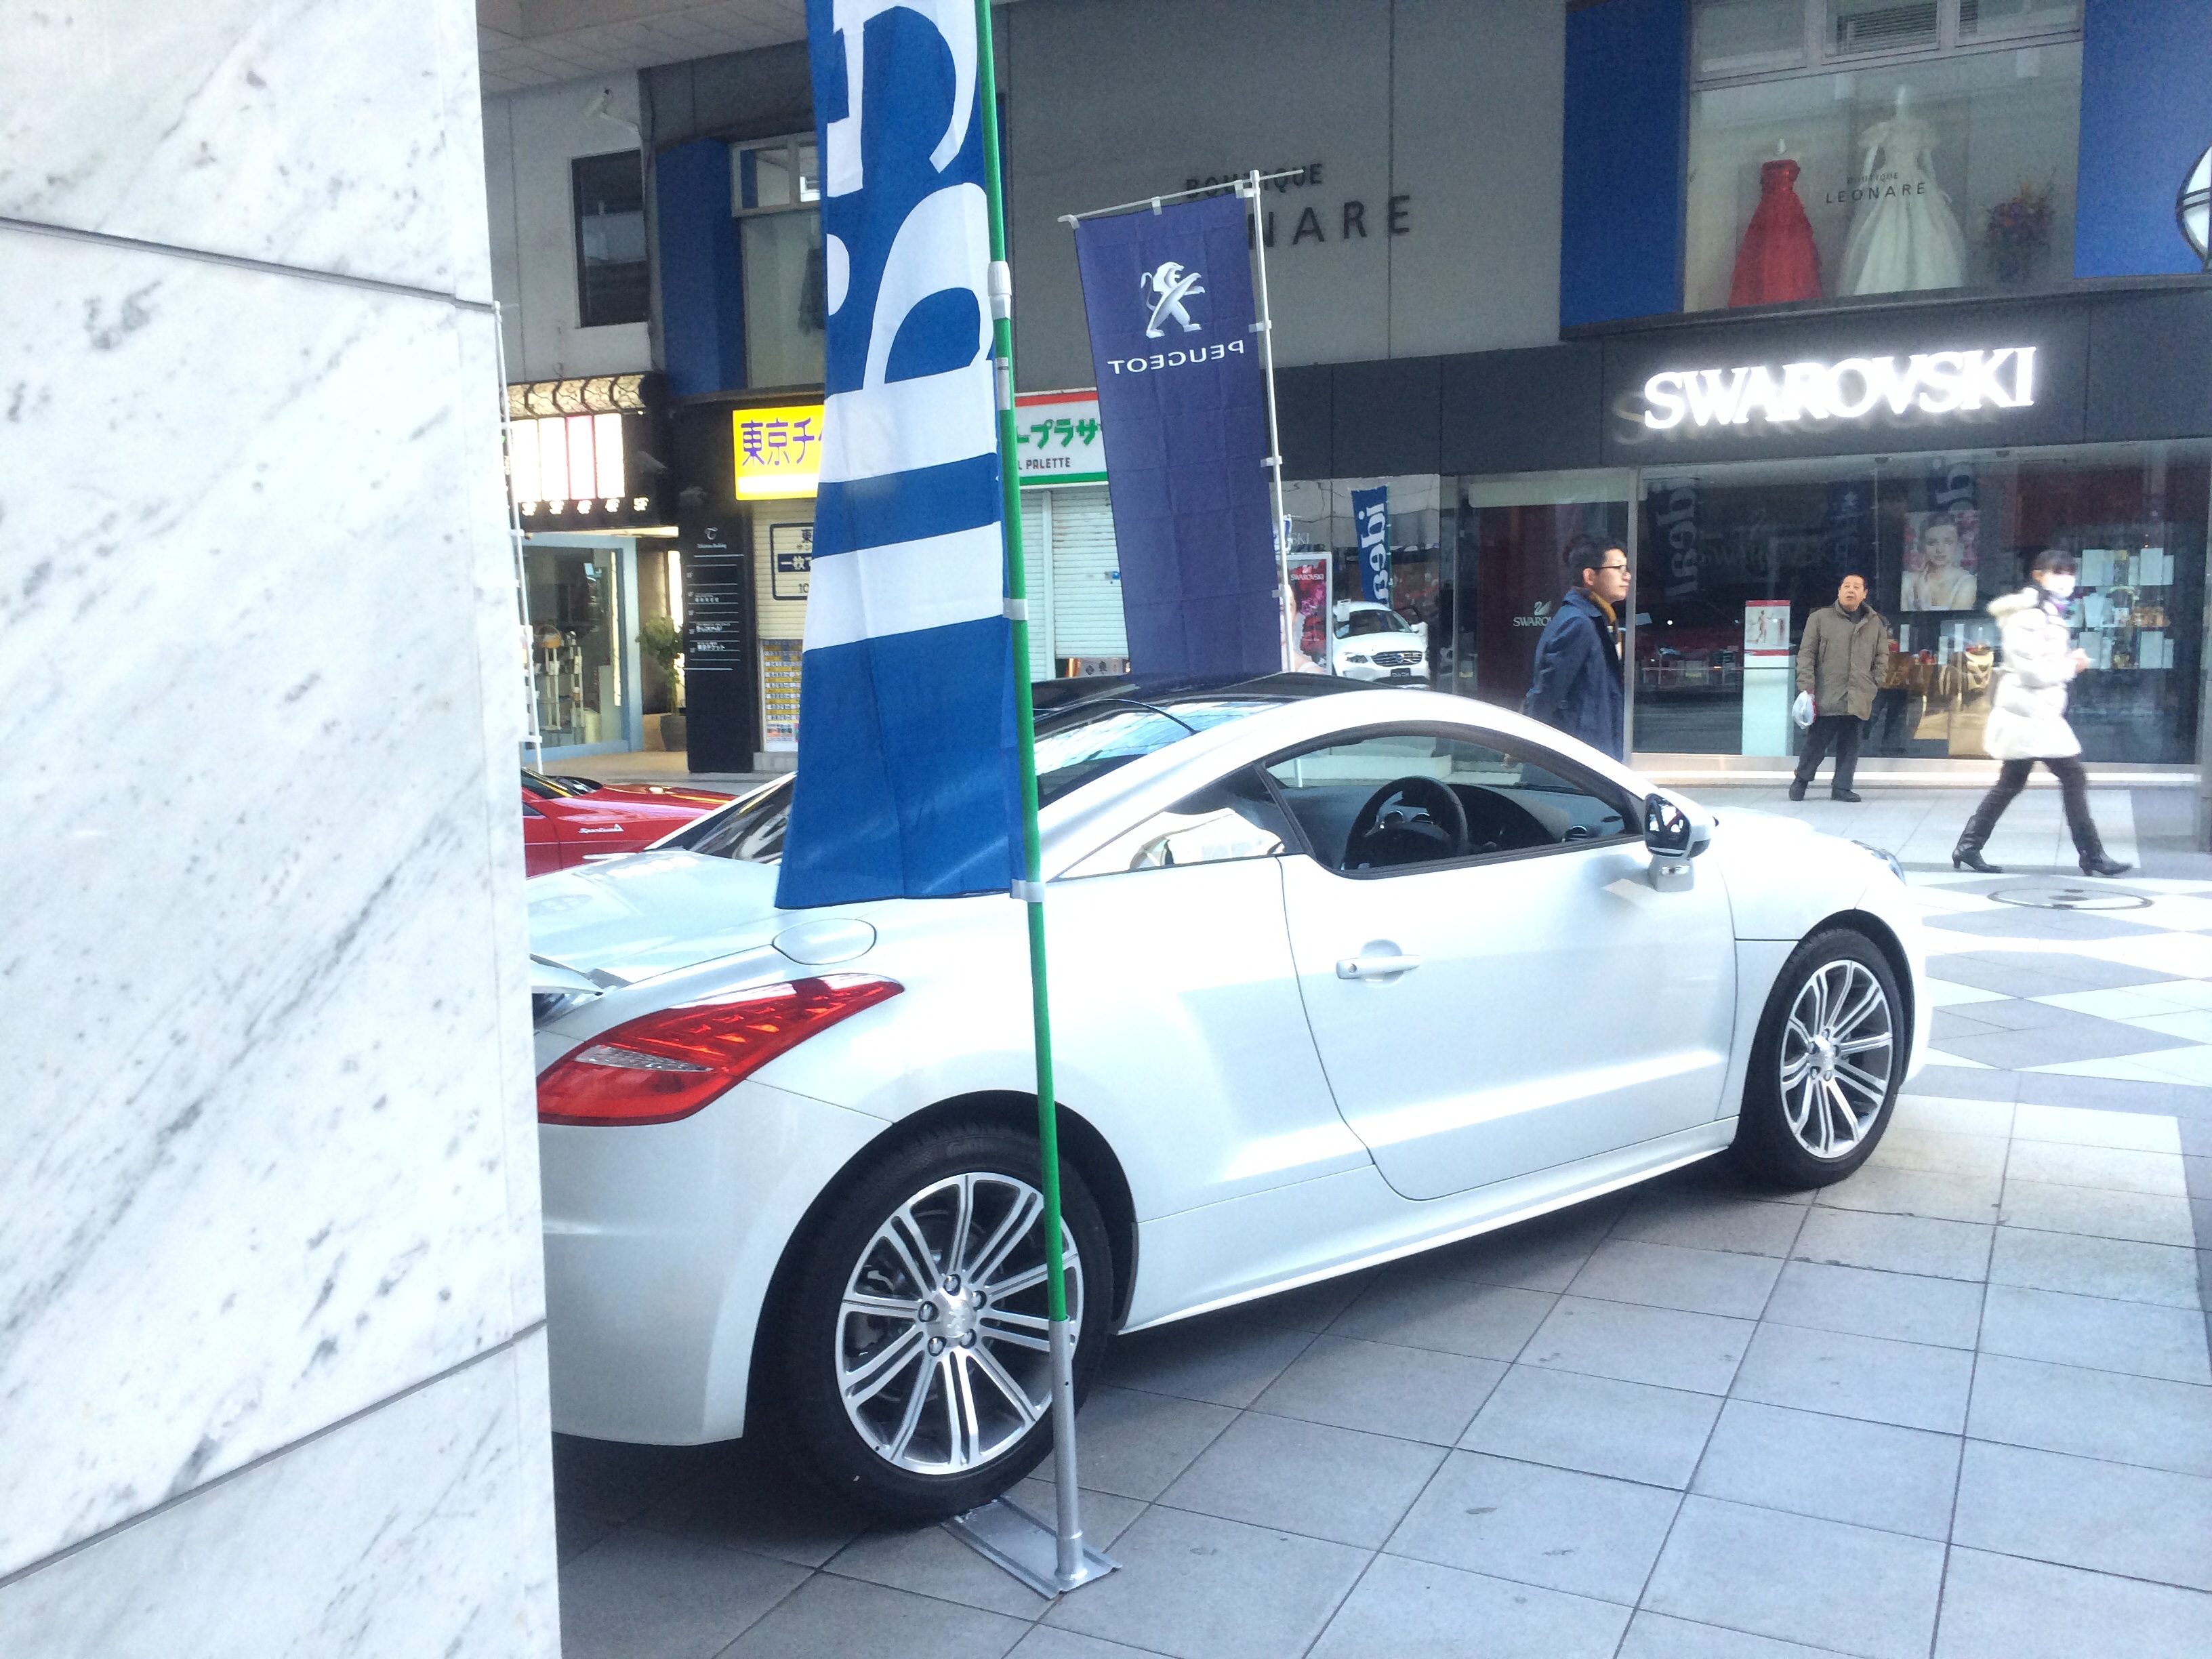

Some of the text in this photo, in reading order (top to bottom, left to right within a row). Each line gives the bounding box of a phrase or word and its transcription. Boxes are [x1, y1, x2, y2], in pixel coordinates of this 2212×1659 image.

[1826, 182, 1925, 204] LEONARE
[1248, 194, 1411, 249] NARE
[1644, 346, 2036, 429] SWAROVSKI
[740, 417, 823, 466] 東京チ
[1026, 457, 1071, 470] PALETTE
[1513, 617, 1551, 627] SWARO
